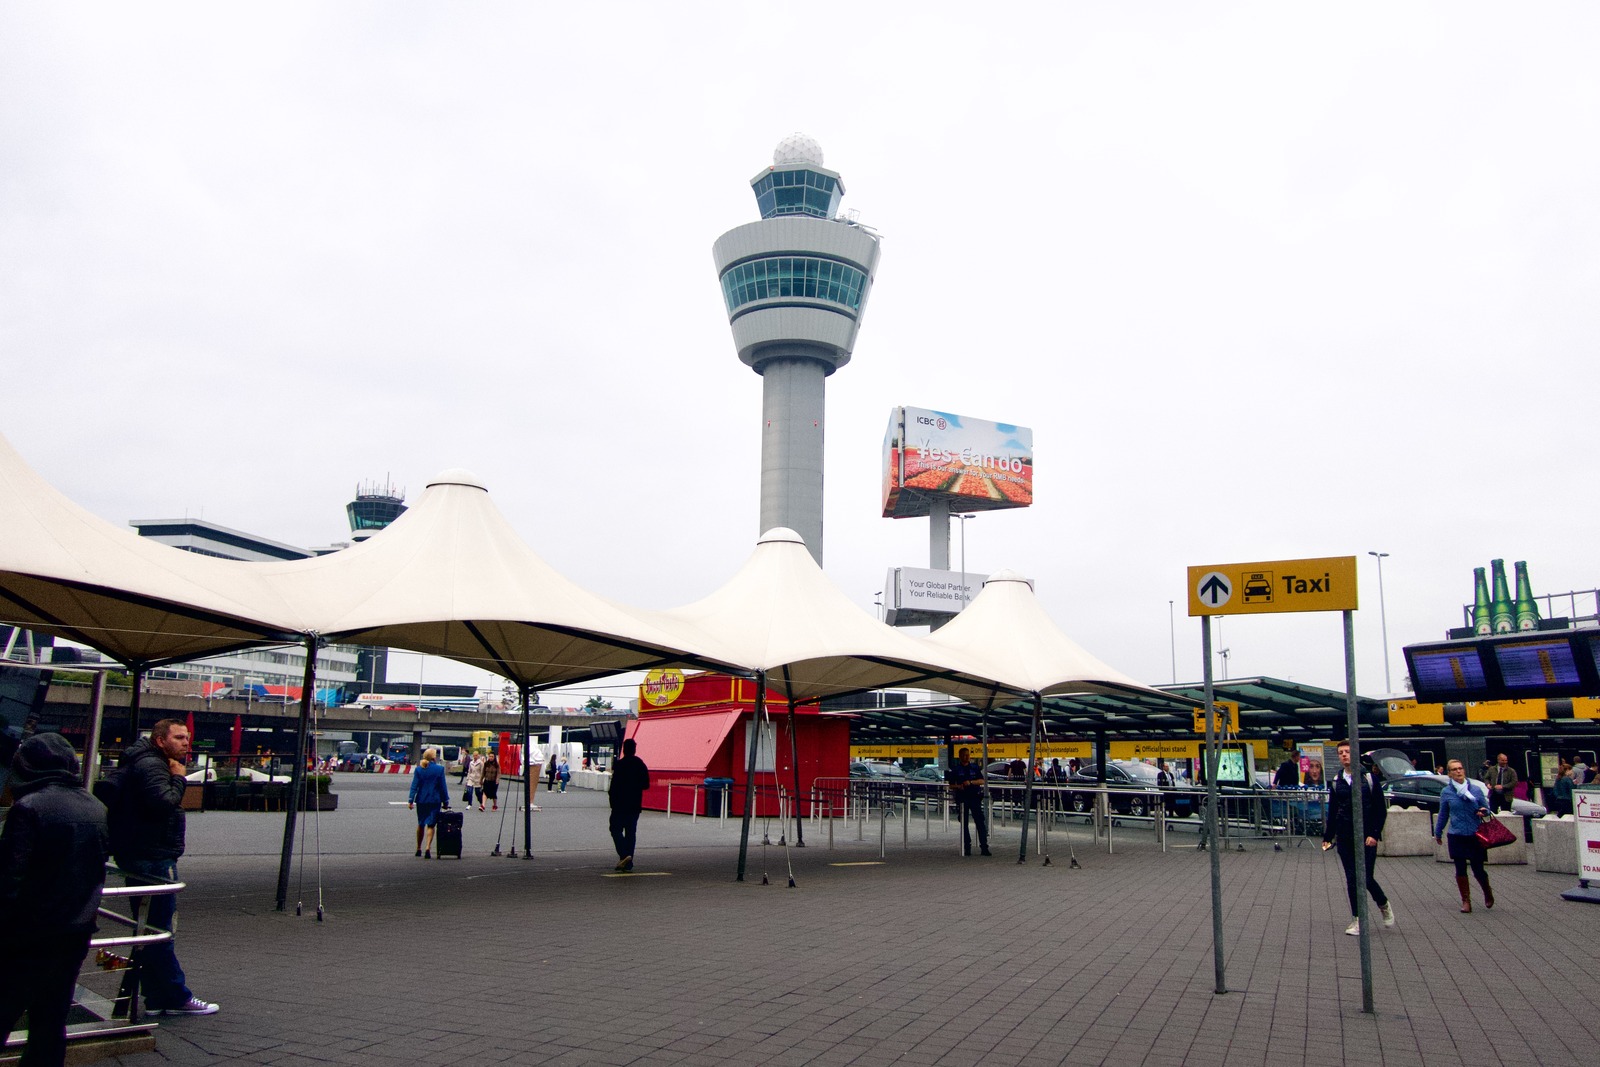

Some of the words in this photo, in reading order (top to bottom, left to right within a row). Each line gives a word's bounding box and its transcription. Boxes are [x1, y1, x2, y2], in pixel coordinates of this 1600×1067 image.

[916, 416, 935, 426] ICBC
[909, 579, 925, 588] Your
[925, 581, 947, 590] Global
[1281, 573, 1330, 594] Taxi
[909, 589, 925, 598] Your
[926, 590, 953, 600] Reliable
[1141, 745, 1160, 753] Official
[1161, 745, 1171, 753] taxi
[1171, 745, 1187, 753] stand
